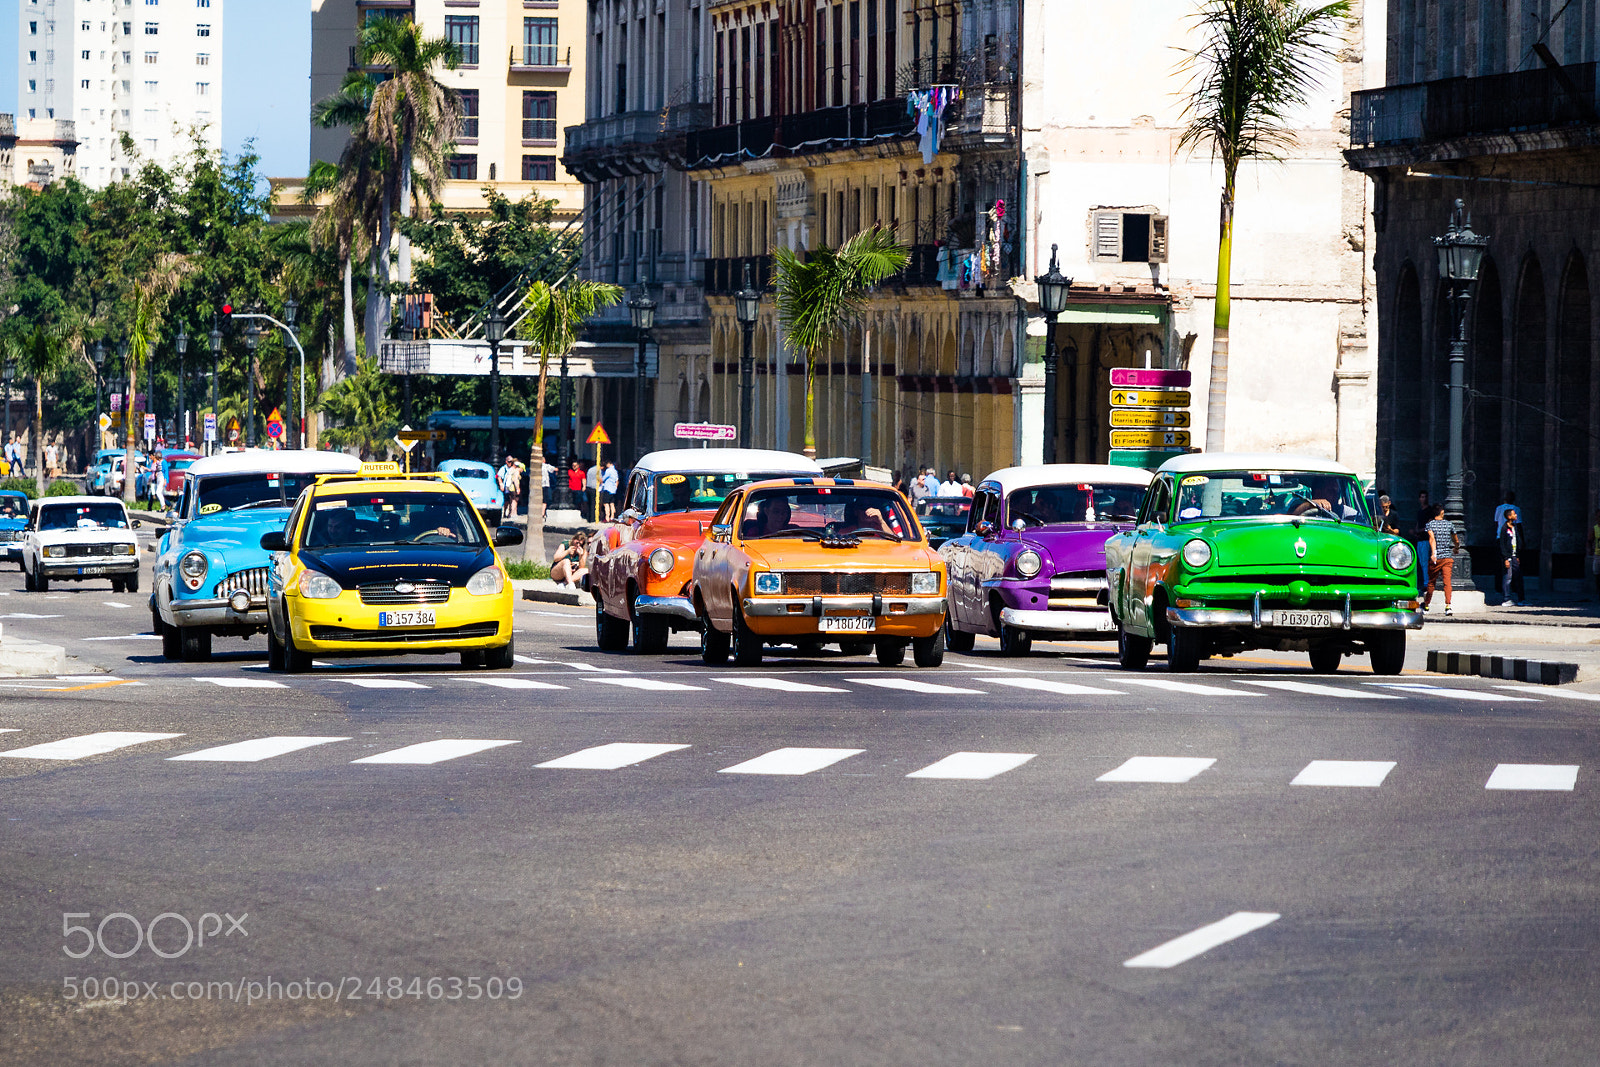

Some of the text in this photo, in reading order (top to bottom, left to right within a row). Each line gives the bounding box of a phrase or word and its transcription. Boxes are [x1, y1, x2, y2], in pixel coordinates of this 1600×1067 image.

[202, 505, 219, 513] TAXI
[396, 613, 413, 625] 157
[416, 612, 434, 624] 384
[835, 618, 854, 629] 180
[1289, 613, 1309, 625] 039
[1310, 613, 1329, 626] 078
